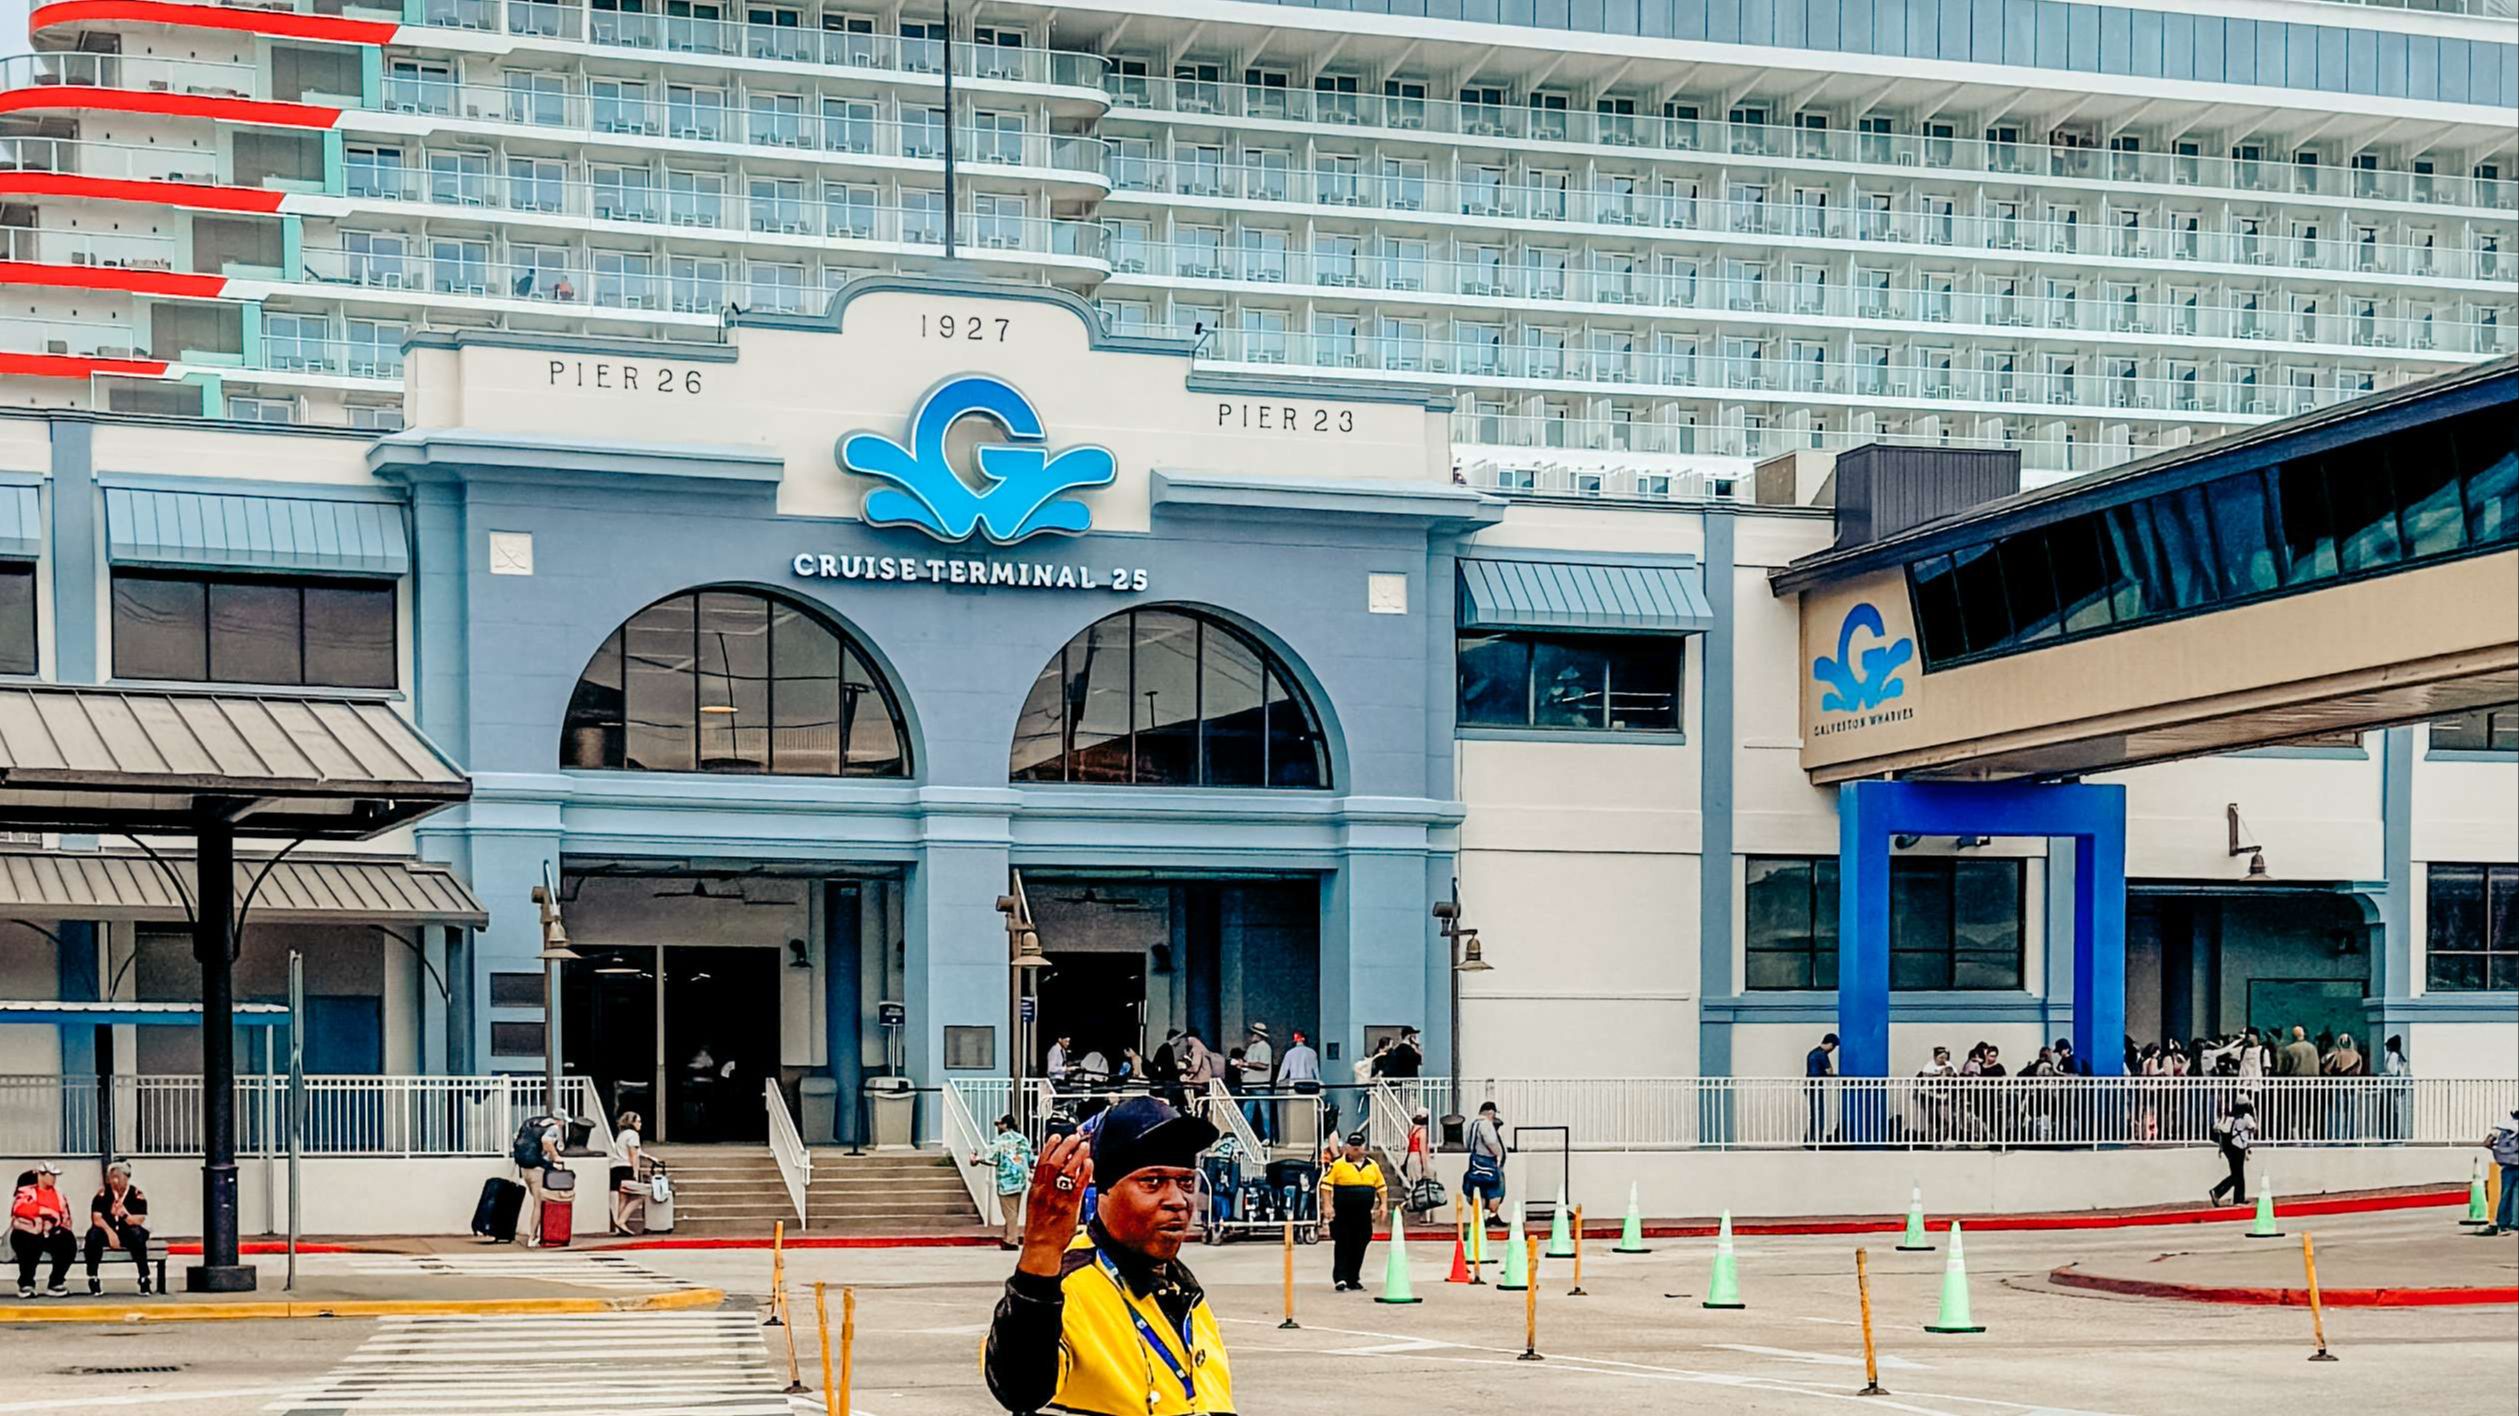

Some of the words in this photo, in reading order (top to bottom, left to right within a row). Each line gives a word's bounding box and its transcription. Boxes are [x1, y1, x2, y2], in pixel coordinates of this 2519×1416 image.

[922, 314, 1009, 342] 1927
[549, 360, 638, 390] PIER
[657, 368, 702, 394] 26
[1218, 403, 1296, 430] PIER
[1313, 409, 1353, 432] 23
[793, 553, 916, 580] CRUISE
[926, 559, 1096, 589] TERMINAL
[1111, 568, 1148, 591] 25
[1814, 717, 1865, 736] GALVESTON
[1869, 708, 1913, 725] WHARVES
